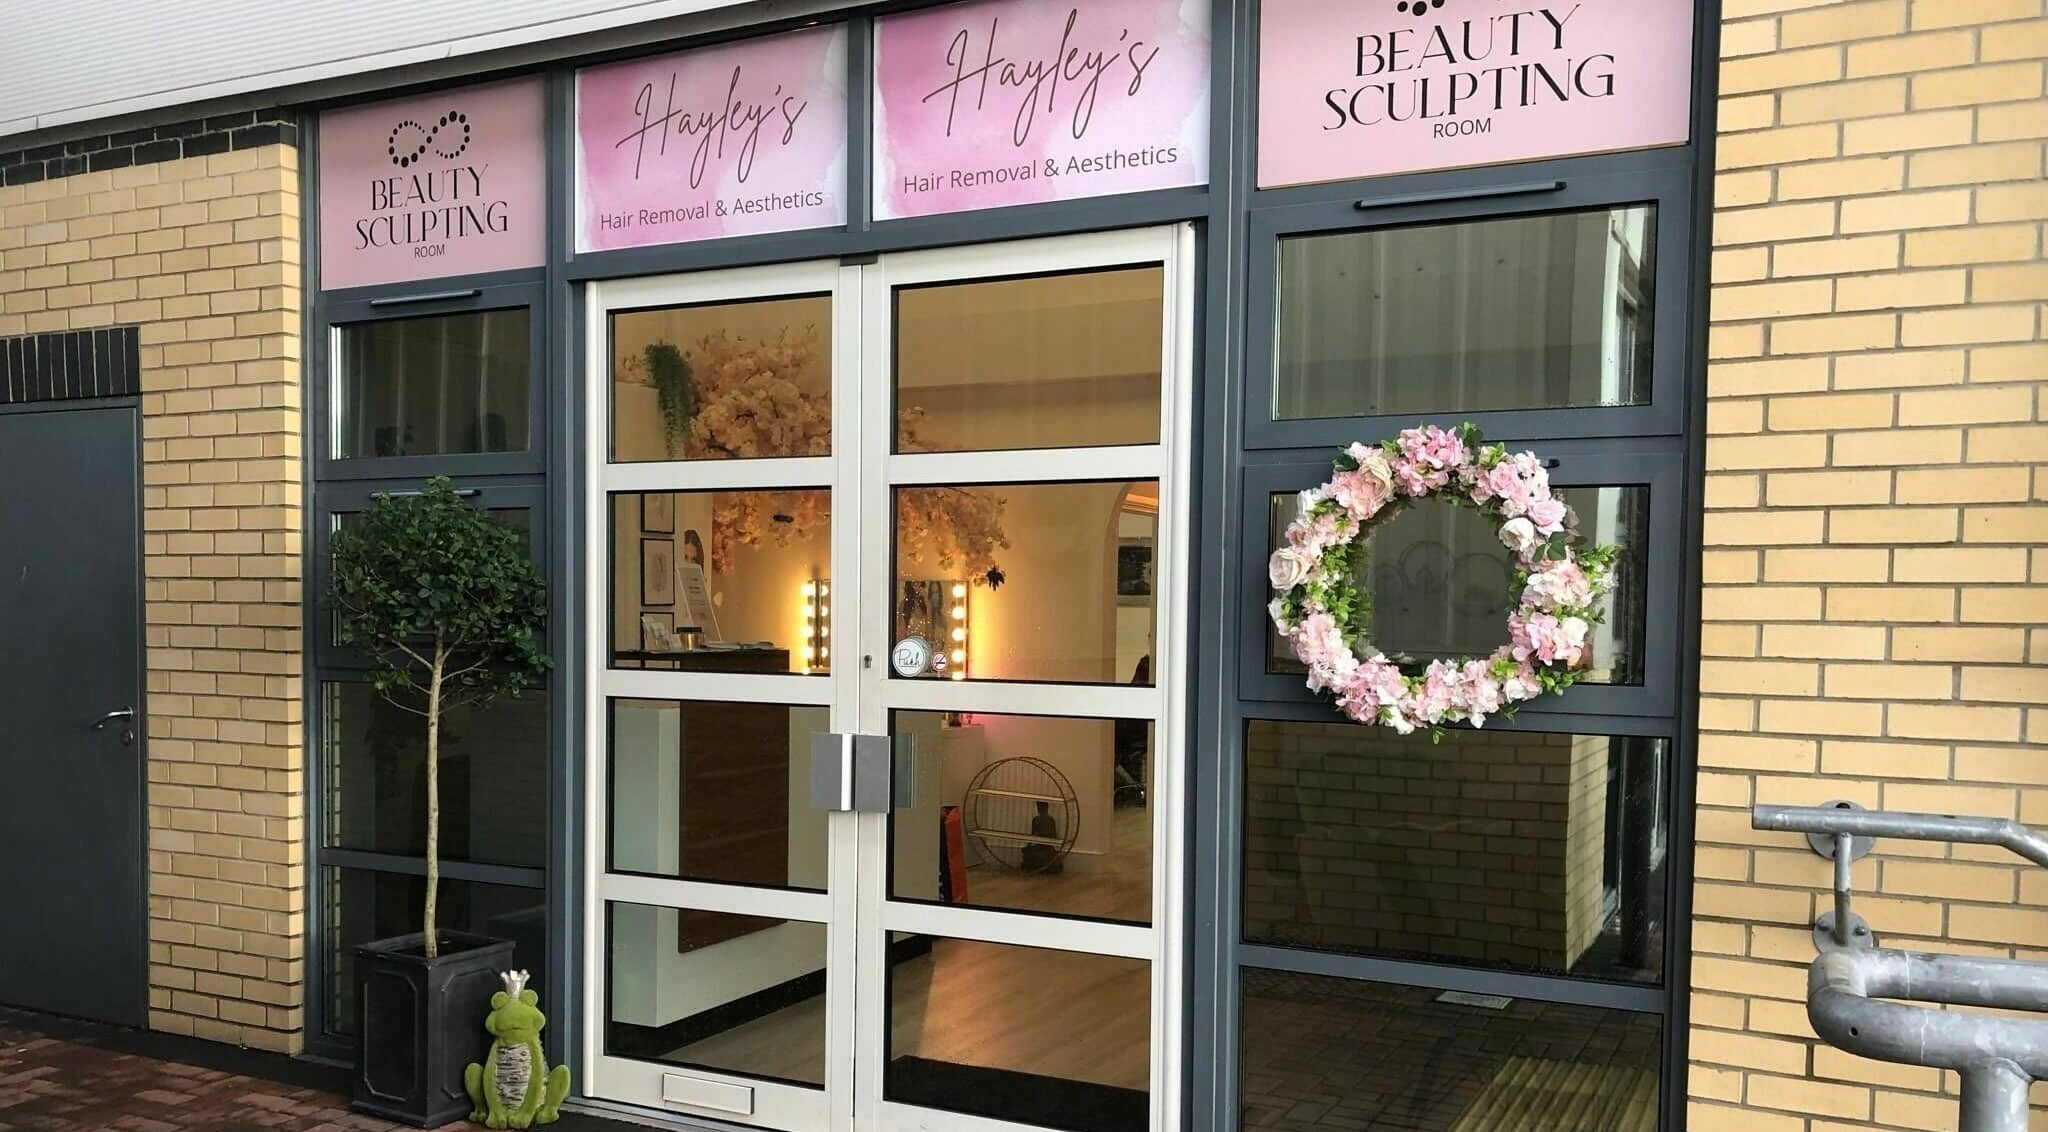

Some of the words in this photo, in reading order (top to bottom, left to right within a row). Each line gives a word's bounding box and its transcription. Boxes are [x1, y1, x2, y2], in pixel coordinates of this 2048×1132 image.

[1355, 3, 1582, 77] BEAUTY
[922, 8, 1159, 147] Hayley's
[1323, 54, 1615, 131] SCULPTING
[615, 66, 807, 189] Hayley's
[1433, 117, 1491, 139] ROOM
[372, 164, 488, 211] BEAUTY
[904, 173, 944, 194] Hair
[950, 160, 1037, 189] Removal
[1044, 158, 1060, 177] &
[1065, 145, 1178, 174] Aesthetics
[356, 201, 508, 250] SCULPTING
[601, 212, 633, 230] Hair
[639, 202, 709, 225] Removal
[715, 200, 728, 217] &
[733, 191, 823, 216] Aesthetics
[414, 244, 445, 259] ROOM
